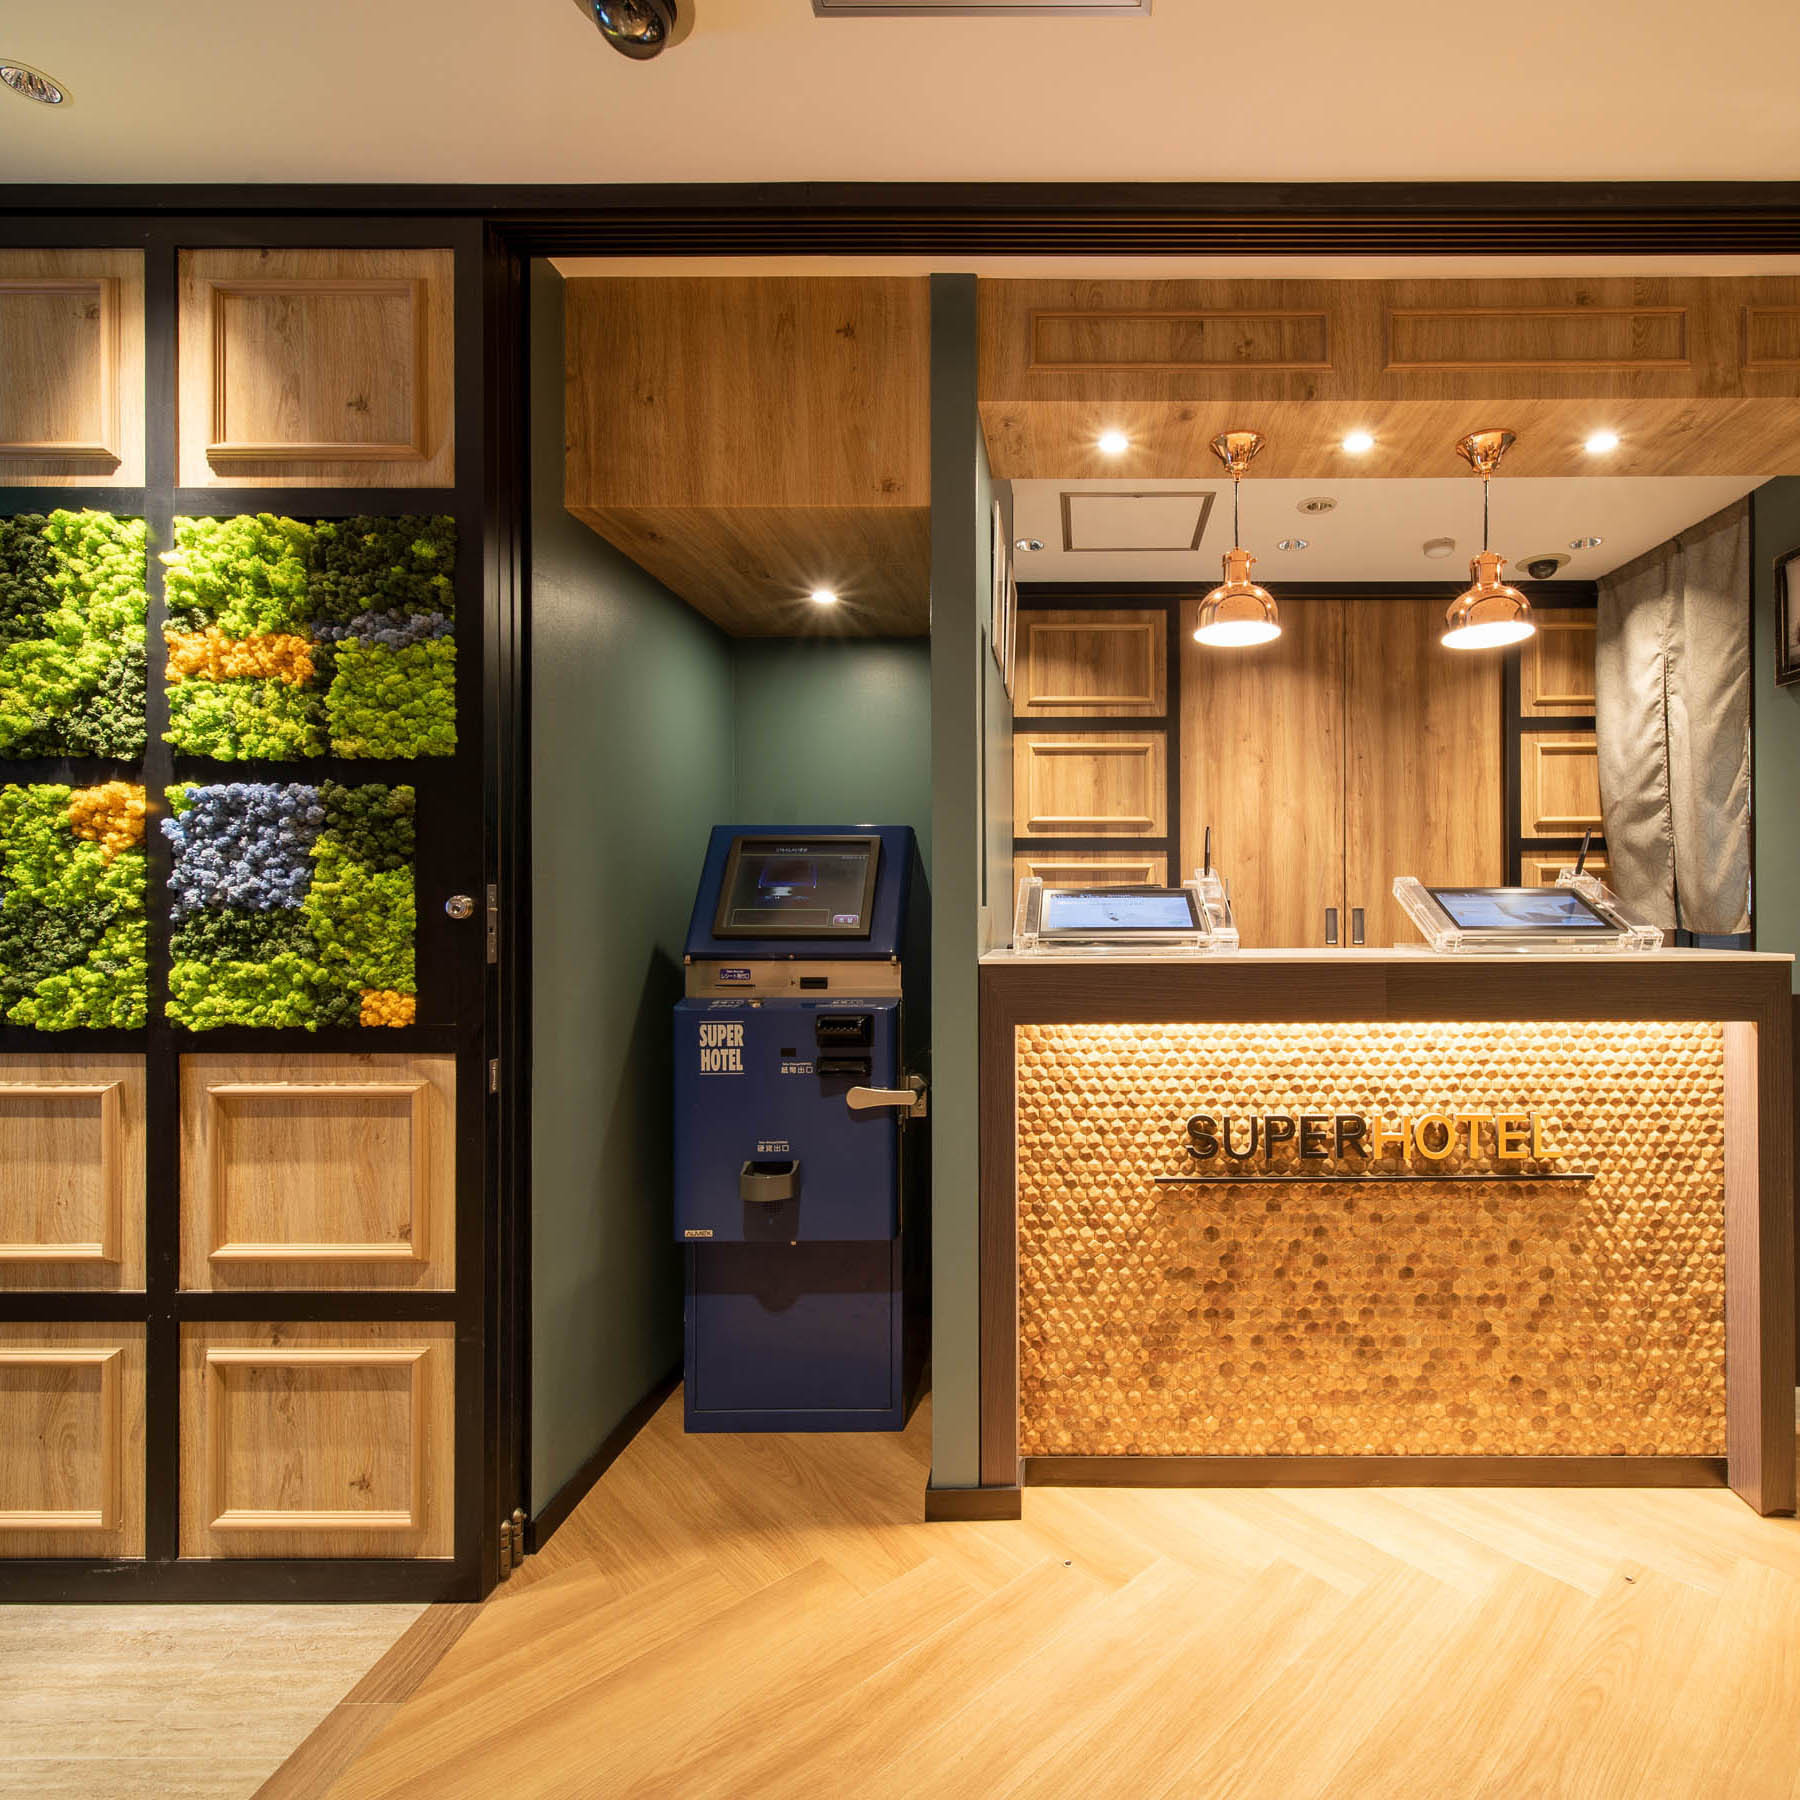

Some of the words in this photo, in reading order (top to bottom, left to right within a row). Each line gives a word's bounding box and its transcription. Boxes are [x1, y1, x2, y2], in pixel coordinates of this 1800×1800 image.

[699, 1024, 744, 1047] SUPER
[700, 1048, 744, 1071] HOTEL
[1185, 1112, 1564, 1160] SUPERHOTEL
